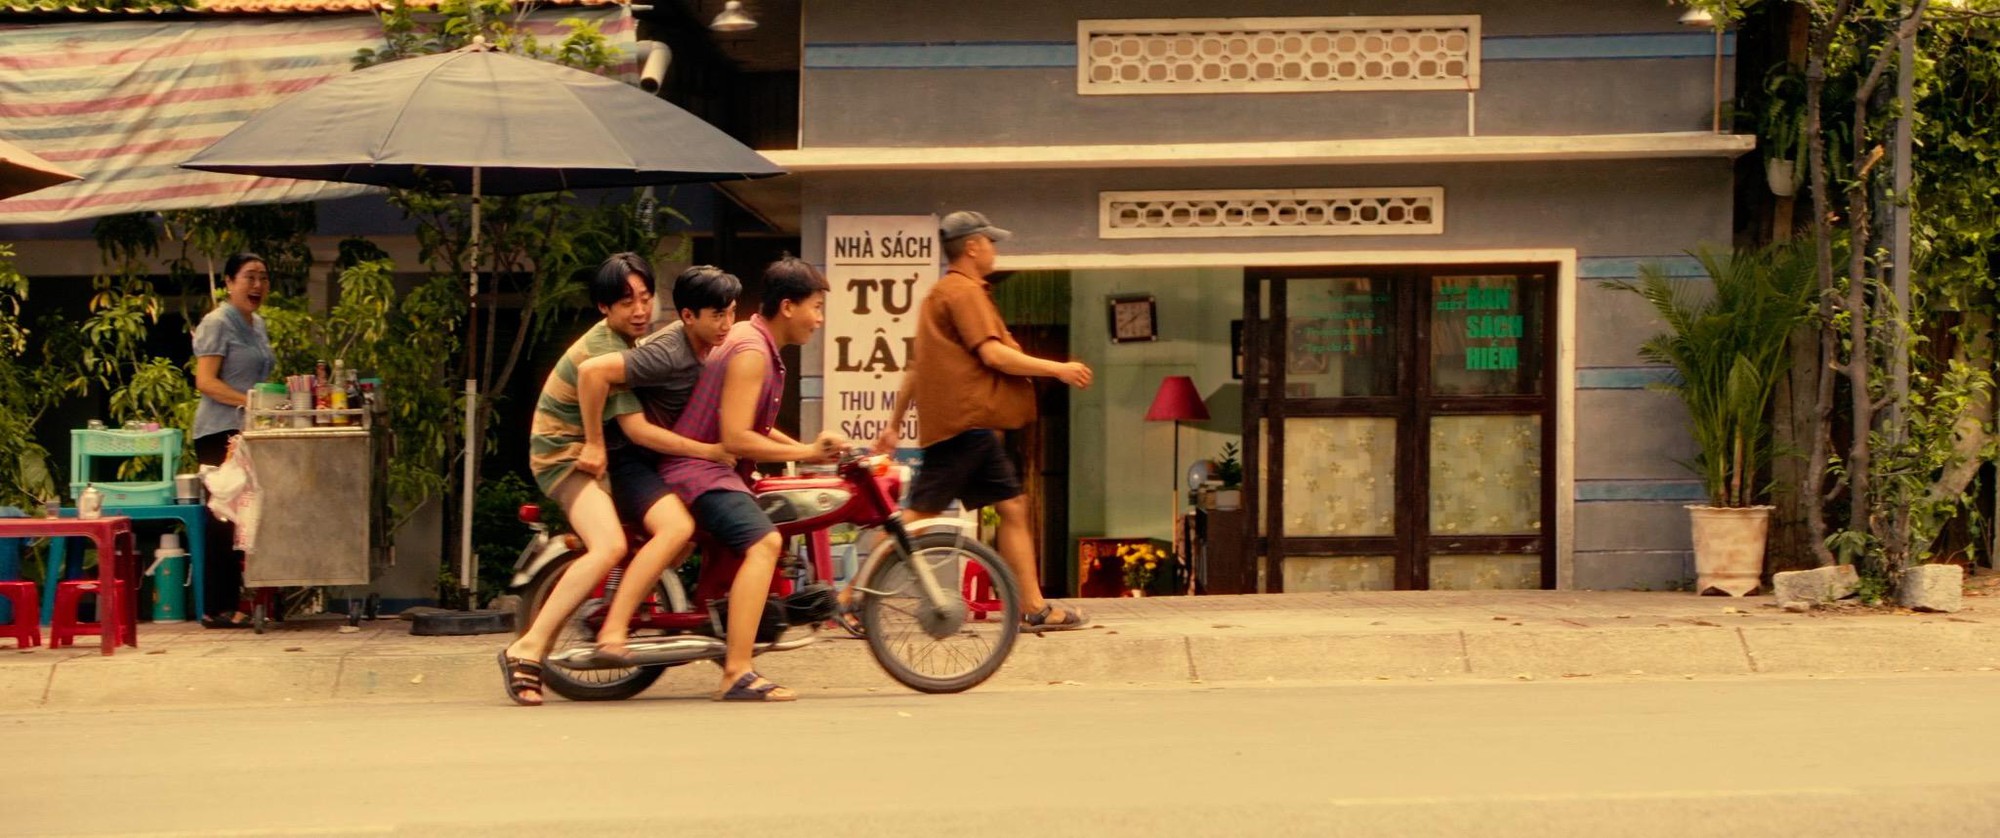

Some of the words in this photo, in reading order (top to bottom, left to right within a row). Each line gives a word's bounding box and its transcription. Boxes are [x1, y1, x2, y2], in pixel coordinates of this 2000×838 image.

[835, 230, 873, 258] NHÀ
[881, 230, 931, 258] SÁCH
[847, 272, 919, 322] TỰ
[1467, 312, 1524, 338] SÁCH
[839, 391, 875, 411] THU
